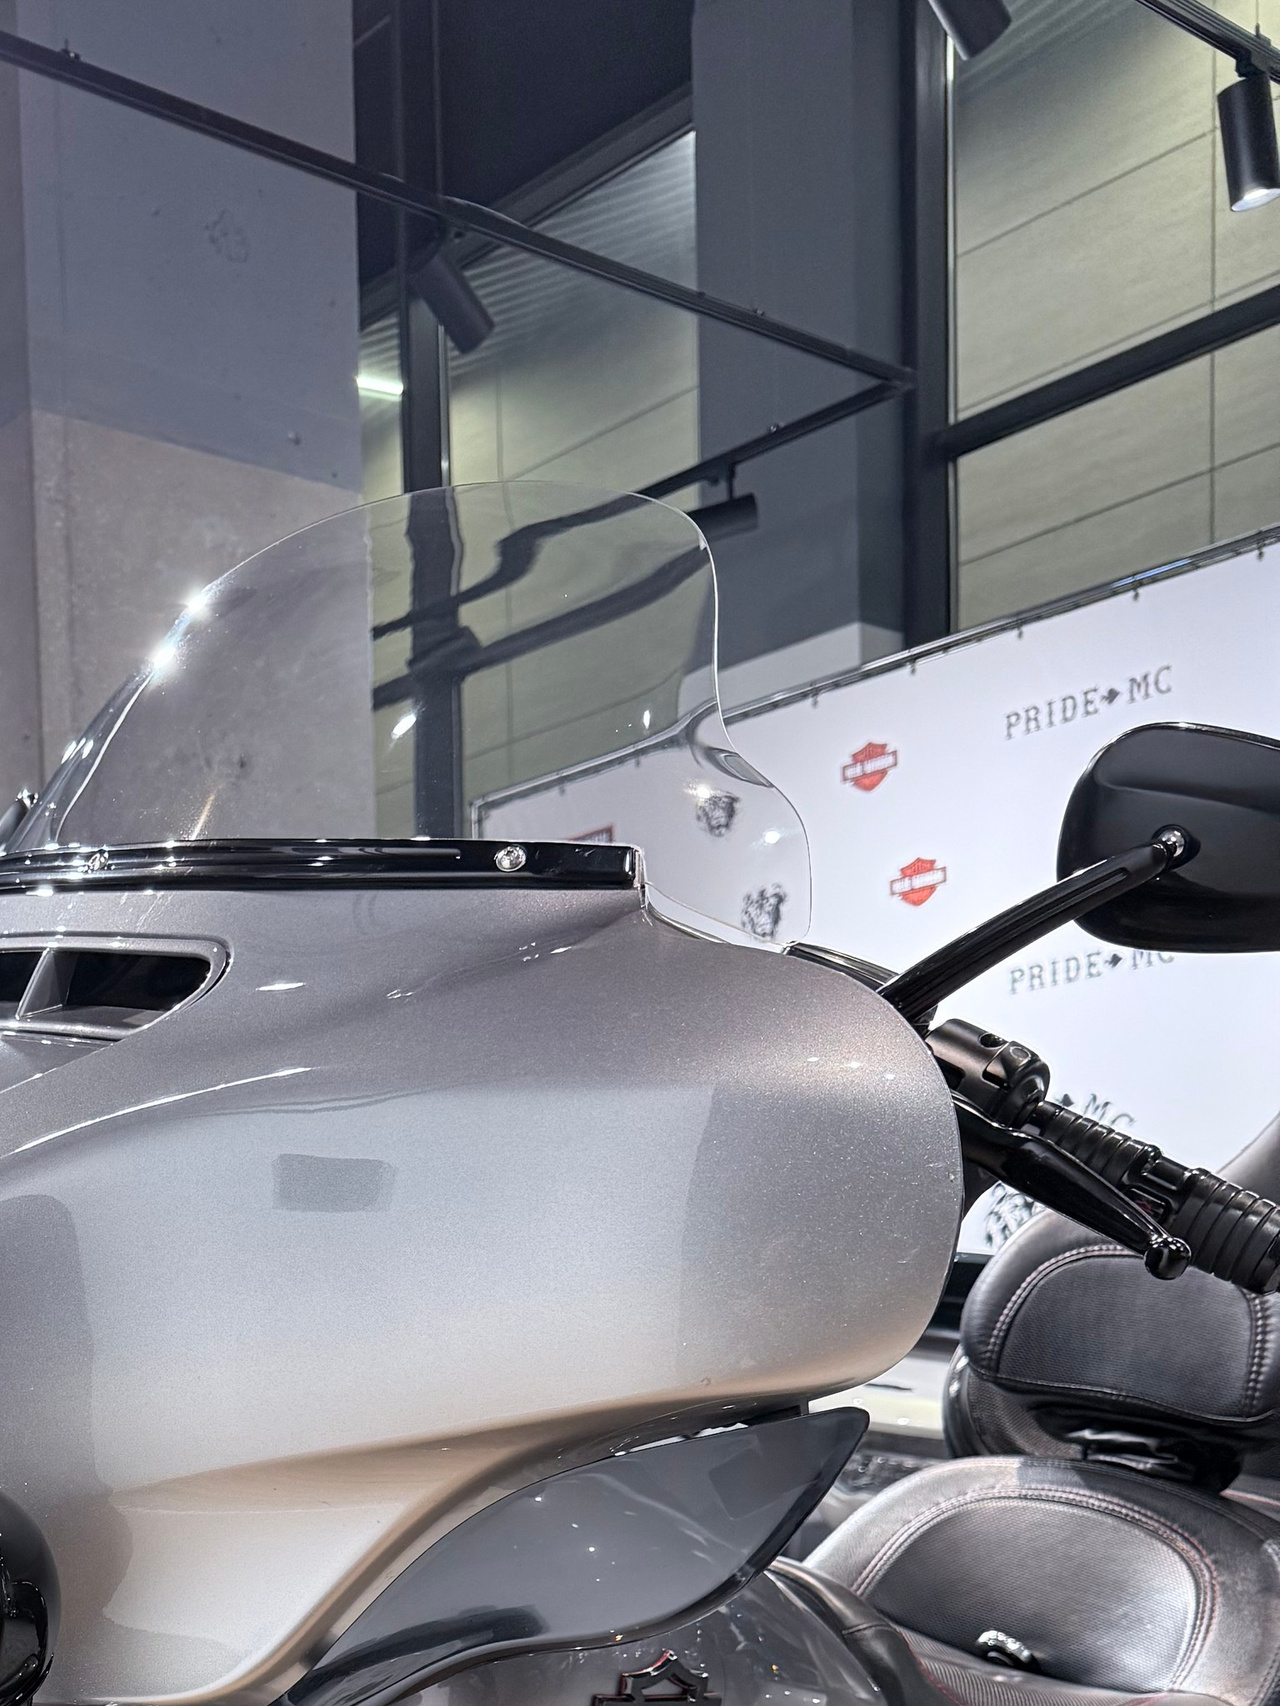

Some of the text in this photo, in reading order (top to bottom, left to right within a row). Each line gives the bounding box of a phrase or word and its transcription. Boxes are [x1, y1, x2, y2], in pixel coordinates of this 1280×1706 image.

[1005, 664, 1172, 740] PRIDE MC
[1010, 950, 1103, 994] PRIDE
